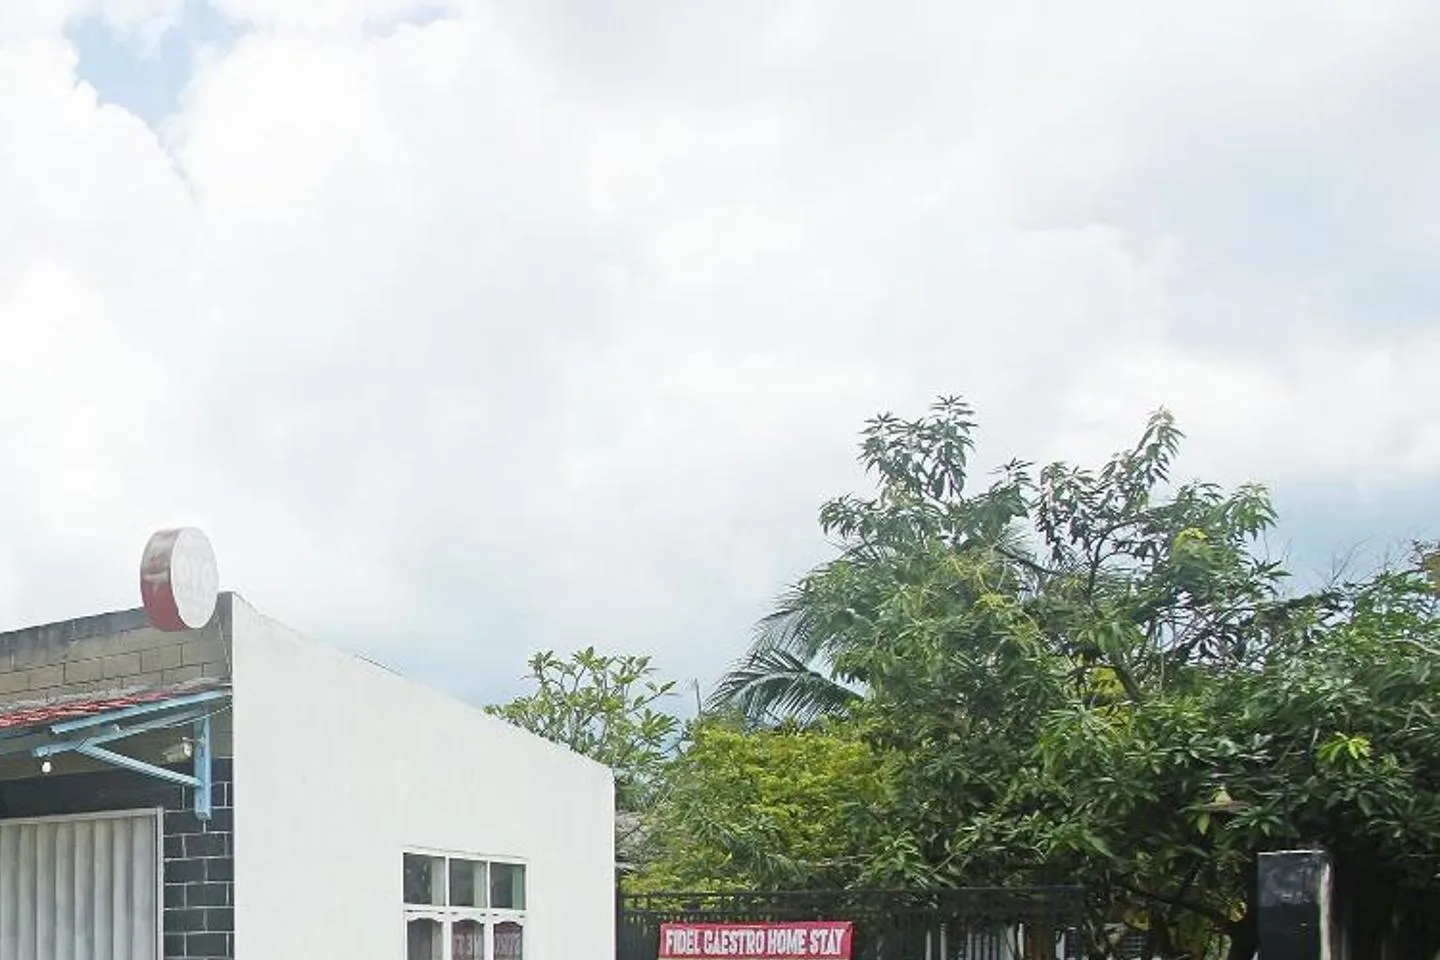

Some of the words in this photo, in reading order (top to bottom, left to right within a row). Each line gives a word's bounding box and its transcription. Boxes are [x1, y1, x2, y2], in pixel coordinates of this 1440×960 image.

[666, 929, 700, 955] FIDEL
[768, 929, 807, 955] HOME
[809, 928, 845, 955] STAY
